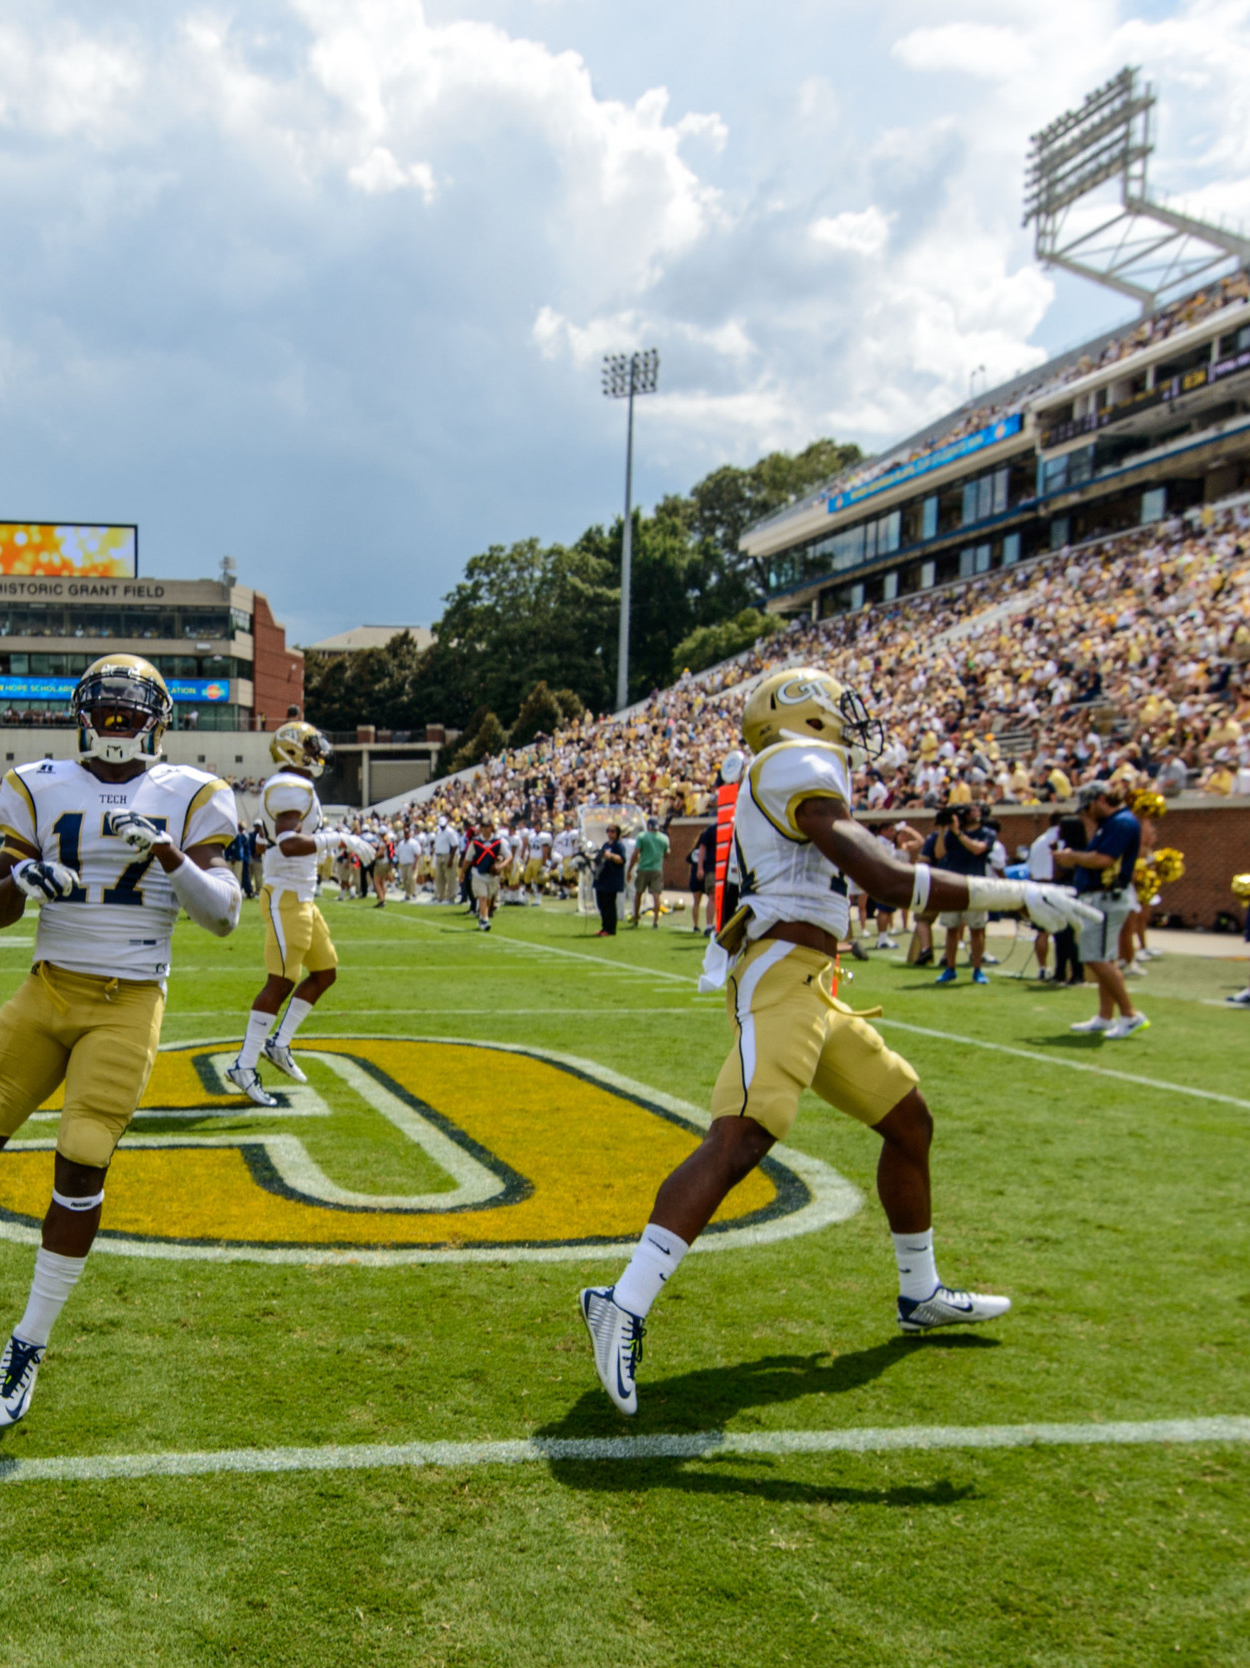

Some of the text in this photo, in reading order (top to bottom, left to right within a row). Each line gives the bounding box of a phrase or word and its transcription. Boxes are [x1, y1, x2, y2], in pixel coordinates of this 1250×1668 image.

[68, 583, 117, 597] GRANT
[124, 585, 165, 598] FIELD
[99, 794, 127, 805] TECH
[52, 810, 169, 906] 17
